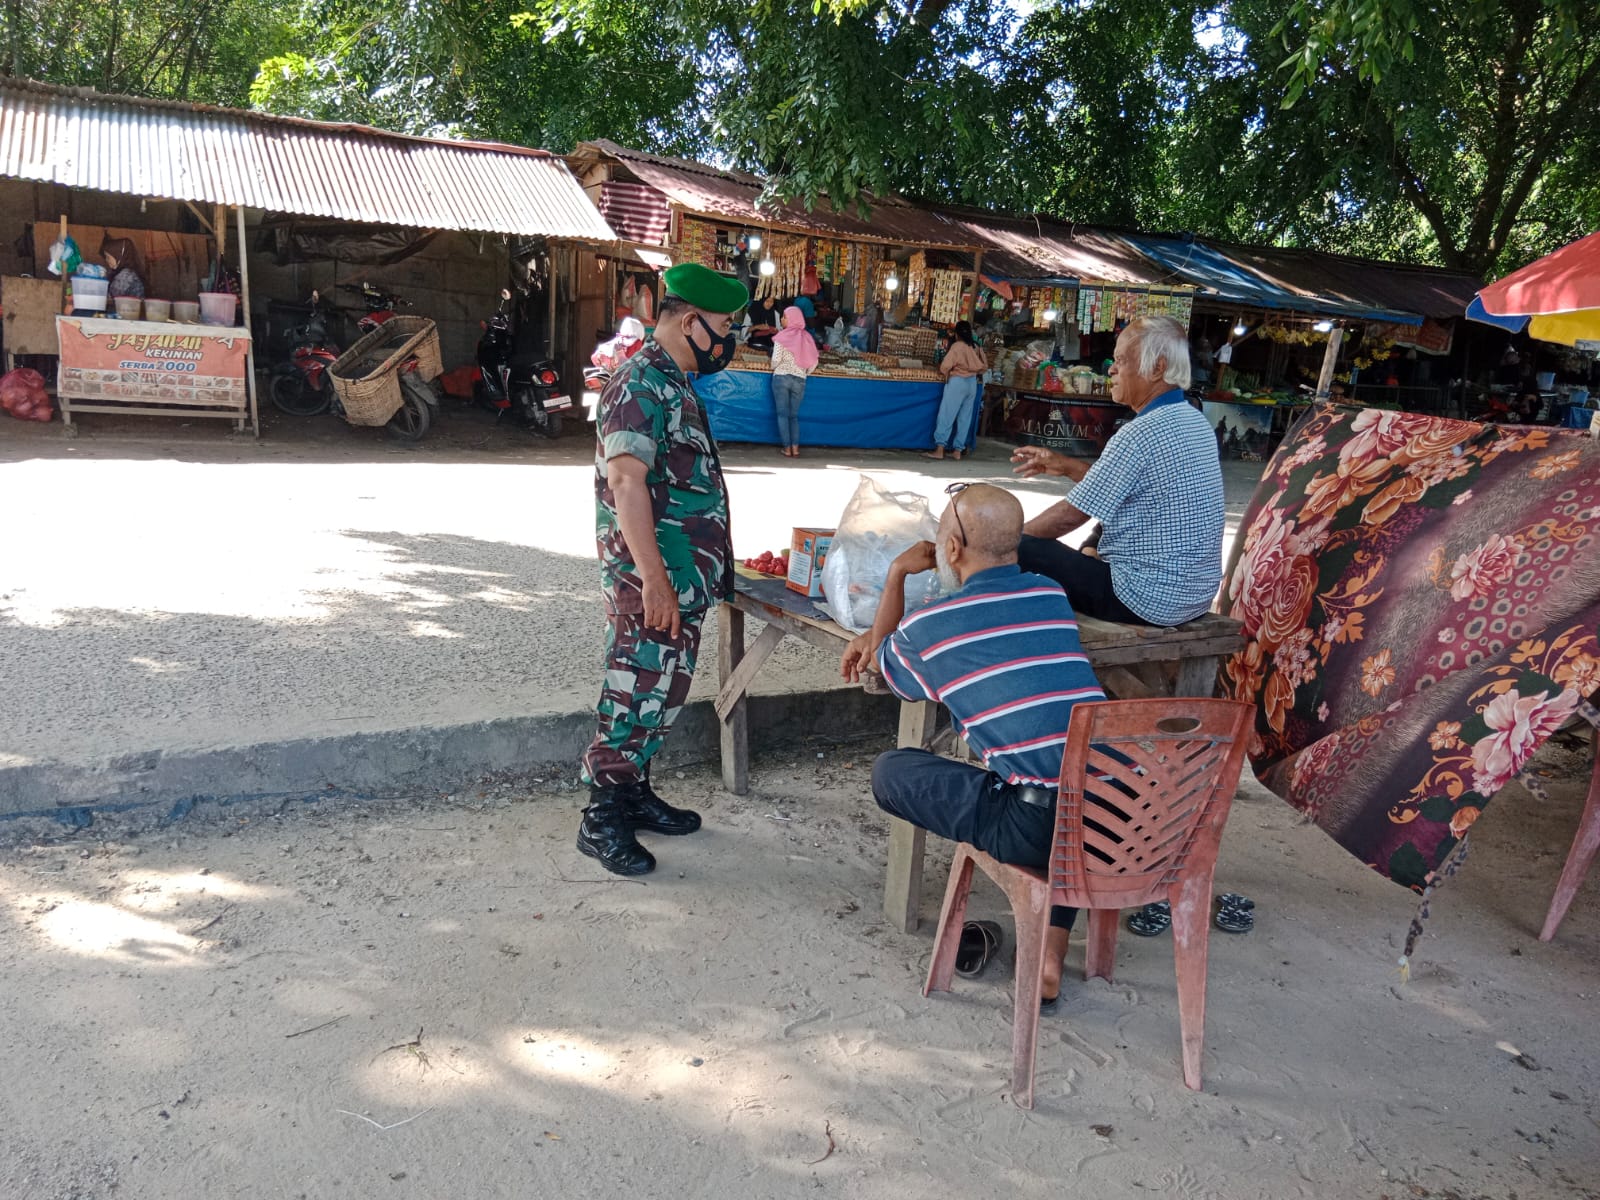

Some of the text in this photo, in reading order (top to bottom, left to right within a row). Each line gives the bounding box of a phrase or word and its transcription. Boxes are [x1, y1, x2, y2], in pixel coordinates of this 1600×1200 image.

[145, 349, 203, 360] KEKINIAN
[119, 360, 196, 372] SERBA 2000
[1021, 418, 1088, 438] MAGNUM
[1037, 439, 1073, 448] LASSIC
